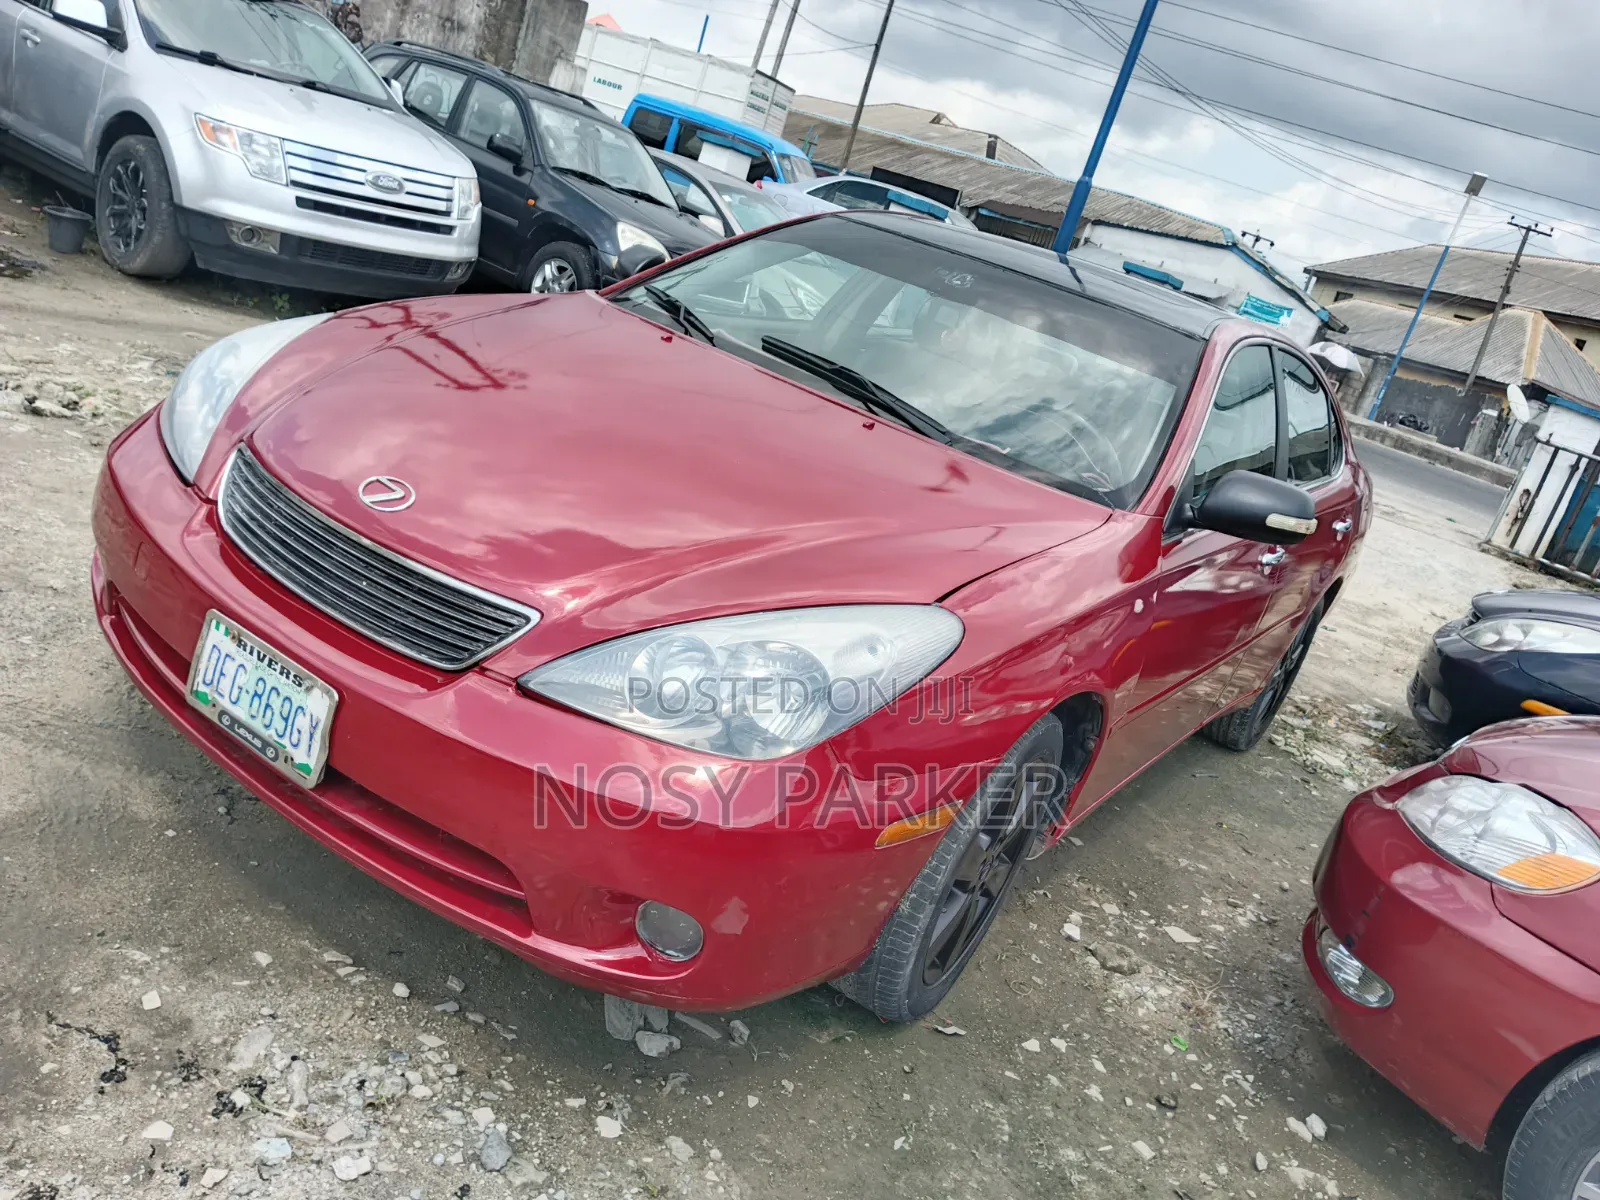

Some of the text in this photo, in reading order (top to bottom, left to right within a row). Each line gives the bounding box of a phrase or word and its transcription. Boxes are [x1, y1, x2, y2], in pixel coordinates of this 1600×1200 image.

[593, 76, 622, 90] LABOUR
[377, 175, 400, 190] Ford
[236, 638, 304, 688] RIVERS
[202, 643, 320, 758] DEG-869GY
[234, 723, 263, 748] LEXUS
